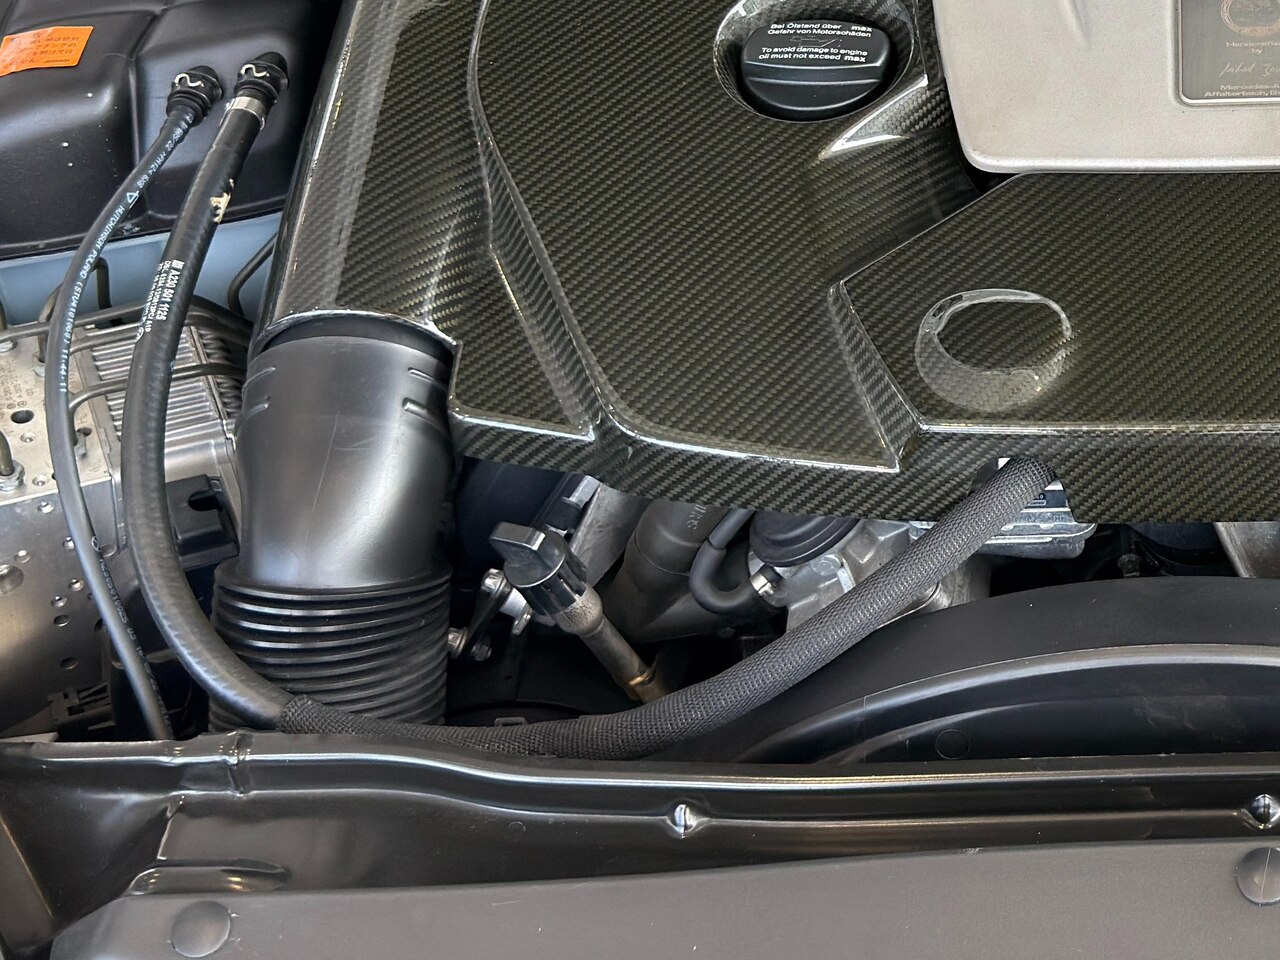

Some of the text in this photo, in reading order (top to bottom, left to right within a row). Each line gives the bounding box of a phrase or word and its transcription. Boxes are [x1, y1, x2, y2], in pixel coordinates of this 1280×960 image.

[812, 28, 872, 38] Motorschäden
[796, 47, 829, 55] damage
[840, 49, 868, 57] engine
[95, 205, 126, 249] HUTCHINSON
[79, 249, 98, 279] POLAND
